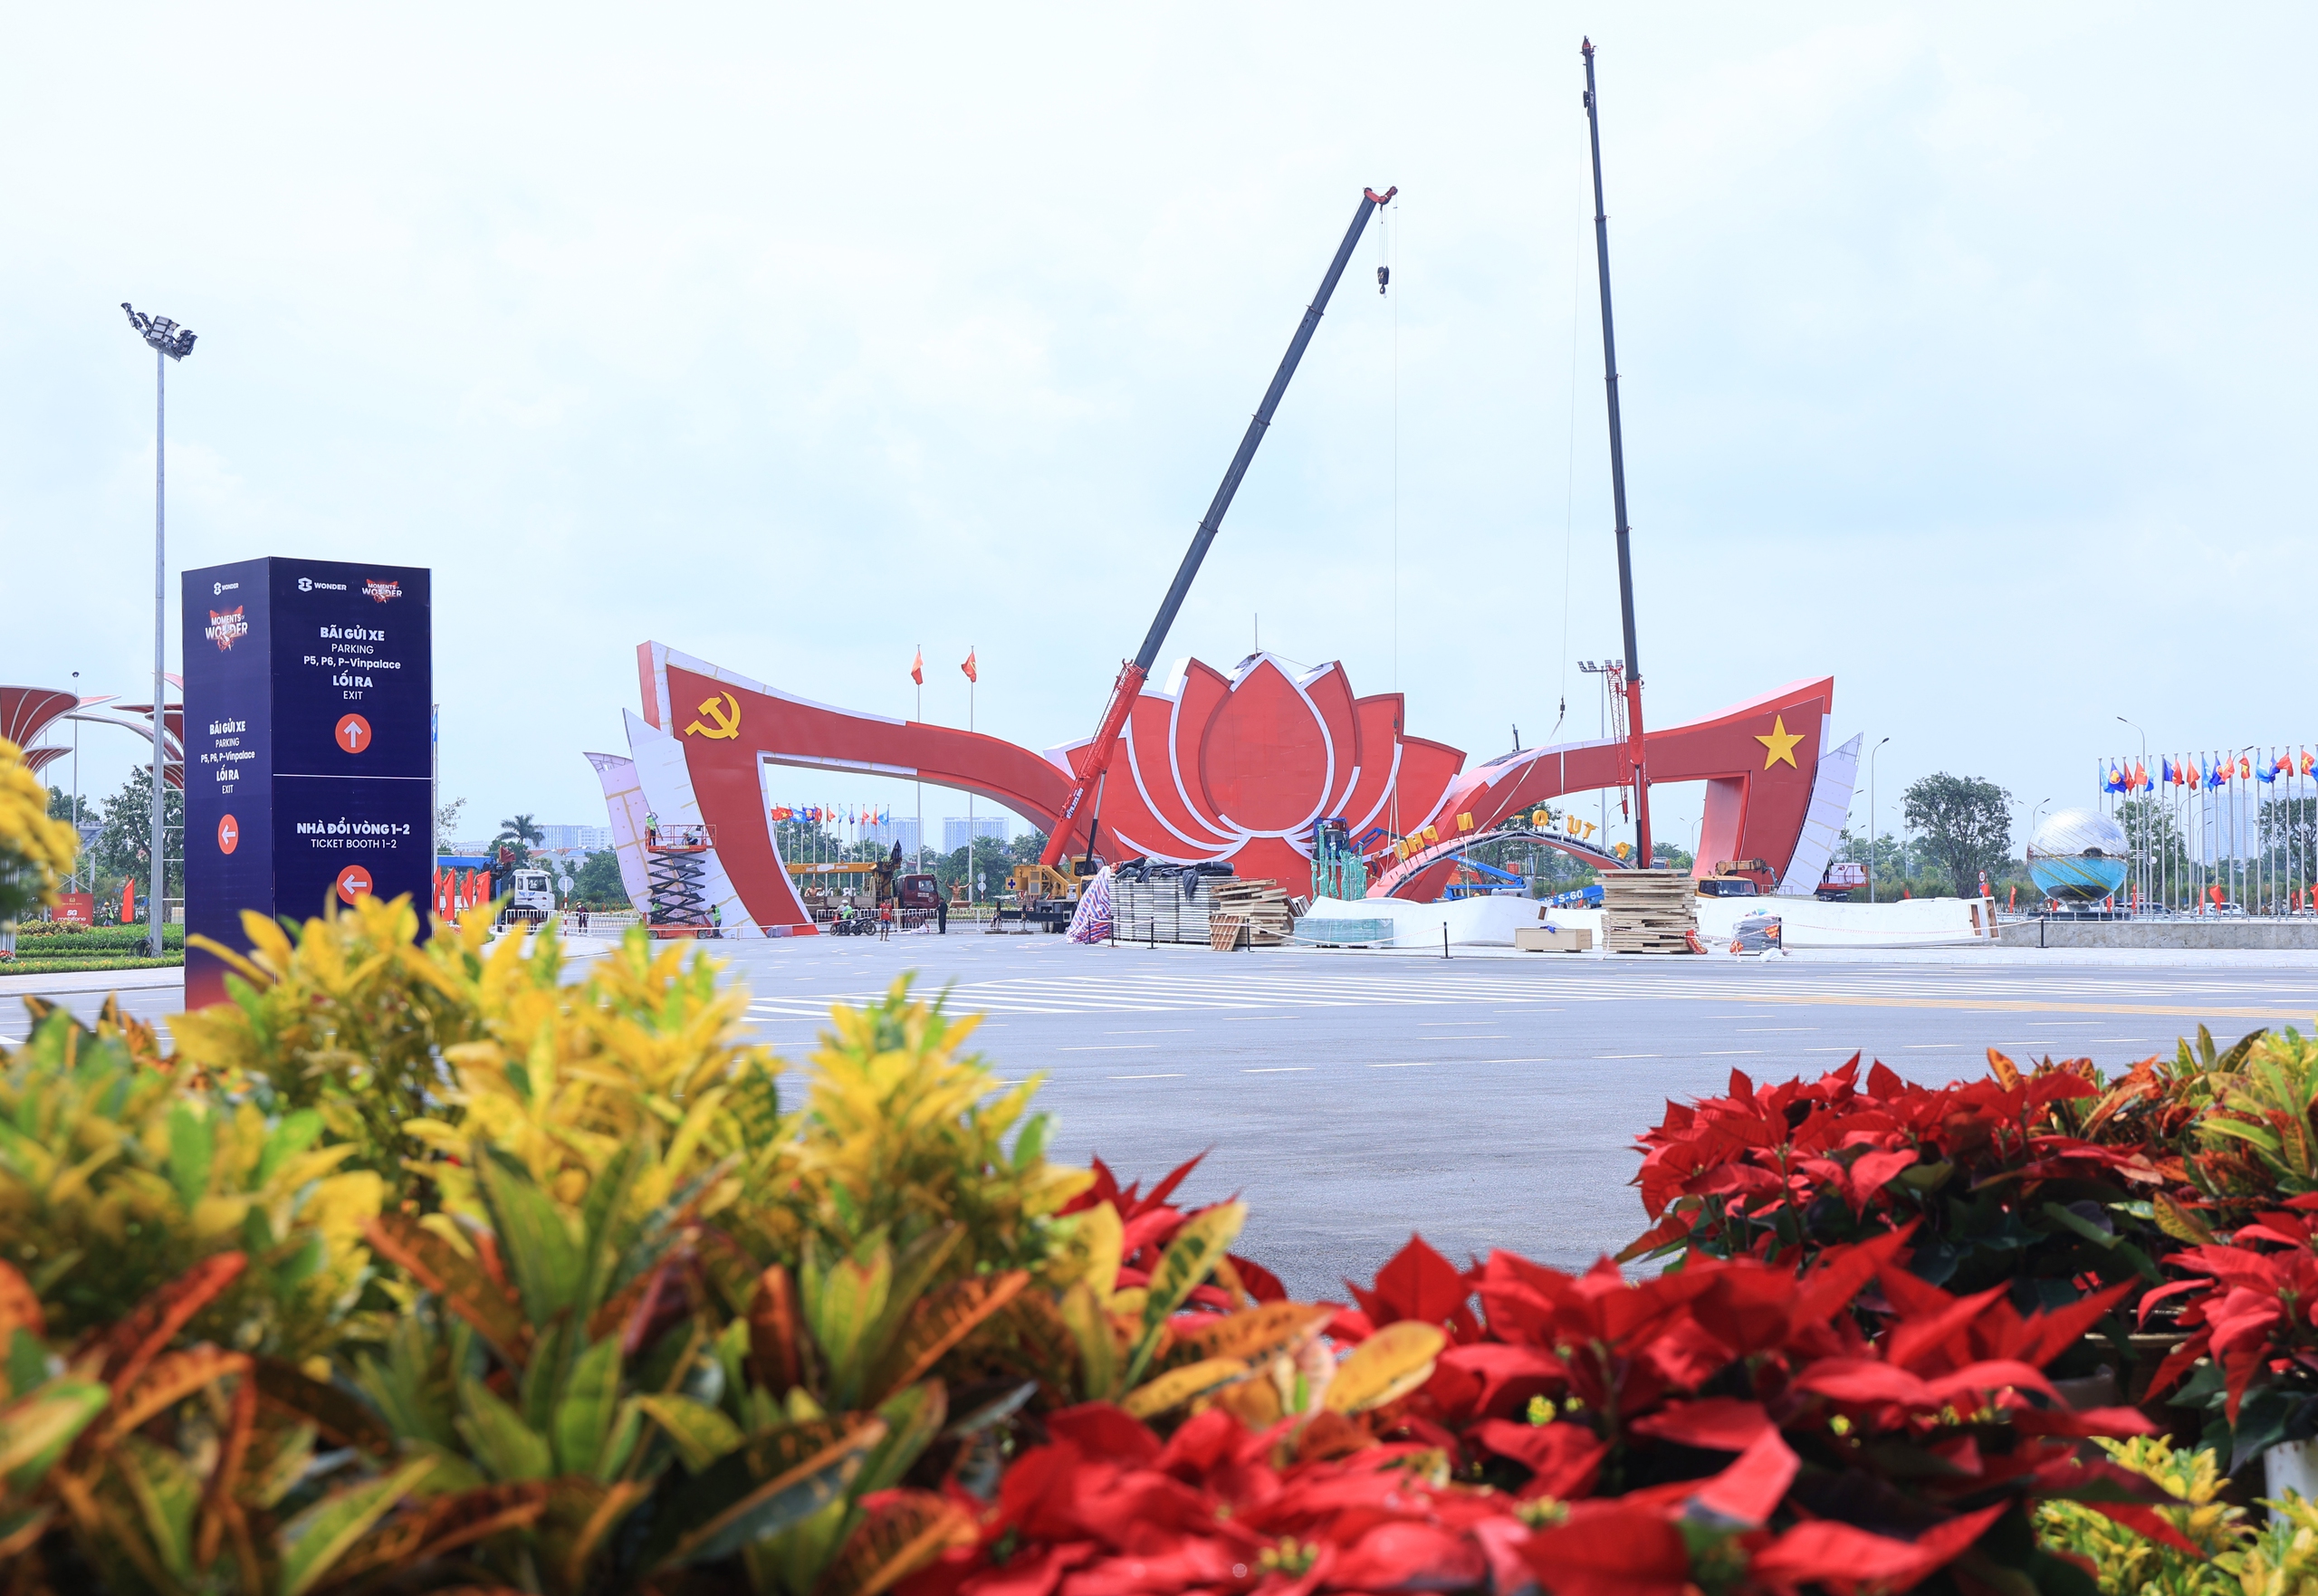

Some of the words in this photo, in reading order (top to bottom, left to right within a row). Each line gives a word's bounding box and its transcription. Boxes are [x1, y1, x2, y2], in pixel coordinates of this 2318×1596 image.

[314, 582, 348, 591] WONDER
[211, 613, 242, 626] MOMENTS
[320, 624, 343, 639] BÃI
[344, 625, 367, 640] GỬI
[369, 630, 385, 641] XE
[331, 644, 374, 655] PARKING
[303, 655, 319, 666] P5,
[321, 656, 336, 667] P6,
[338, 657, 401, 671] P-Vinpalace
[332, 670, 353, 686] LỐI
[354, 676, 373, 687] RA
[343, 691, 363, 700] EXIT
[209, 721, 222, 735] BÃI
[222, 717, 235, 733] GỬI
[235, 721, 246, 732] XE
[216, 738, 240, 748] PARKING
[200, 753, 210, 764] P5,
[209, 752, 219, 763] P6,
[219, 750, 255, 763] P-Vinpalace
[216, 764, 228, 781] LỐI
[228, 769, 239, 780] RA
[222, 784, 234, 794] EXIT
[297, 819, 326, 834] NHÀ
[327, 817, 350, 834] ĐỔI
[352, 819, 389, 835] VÒNG
[391, 823, 410, 835] 1-2
[311, 838, 343, 848] TICKET
[346, 838, 379, 848] BOOTH
[381, 838, 397, 848] 1-2
[1557, 889, 1584, 903] S-60
